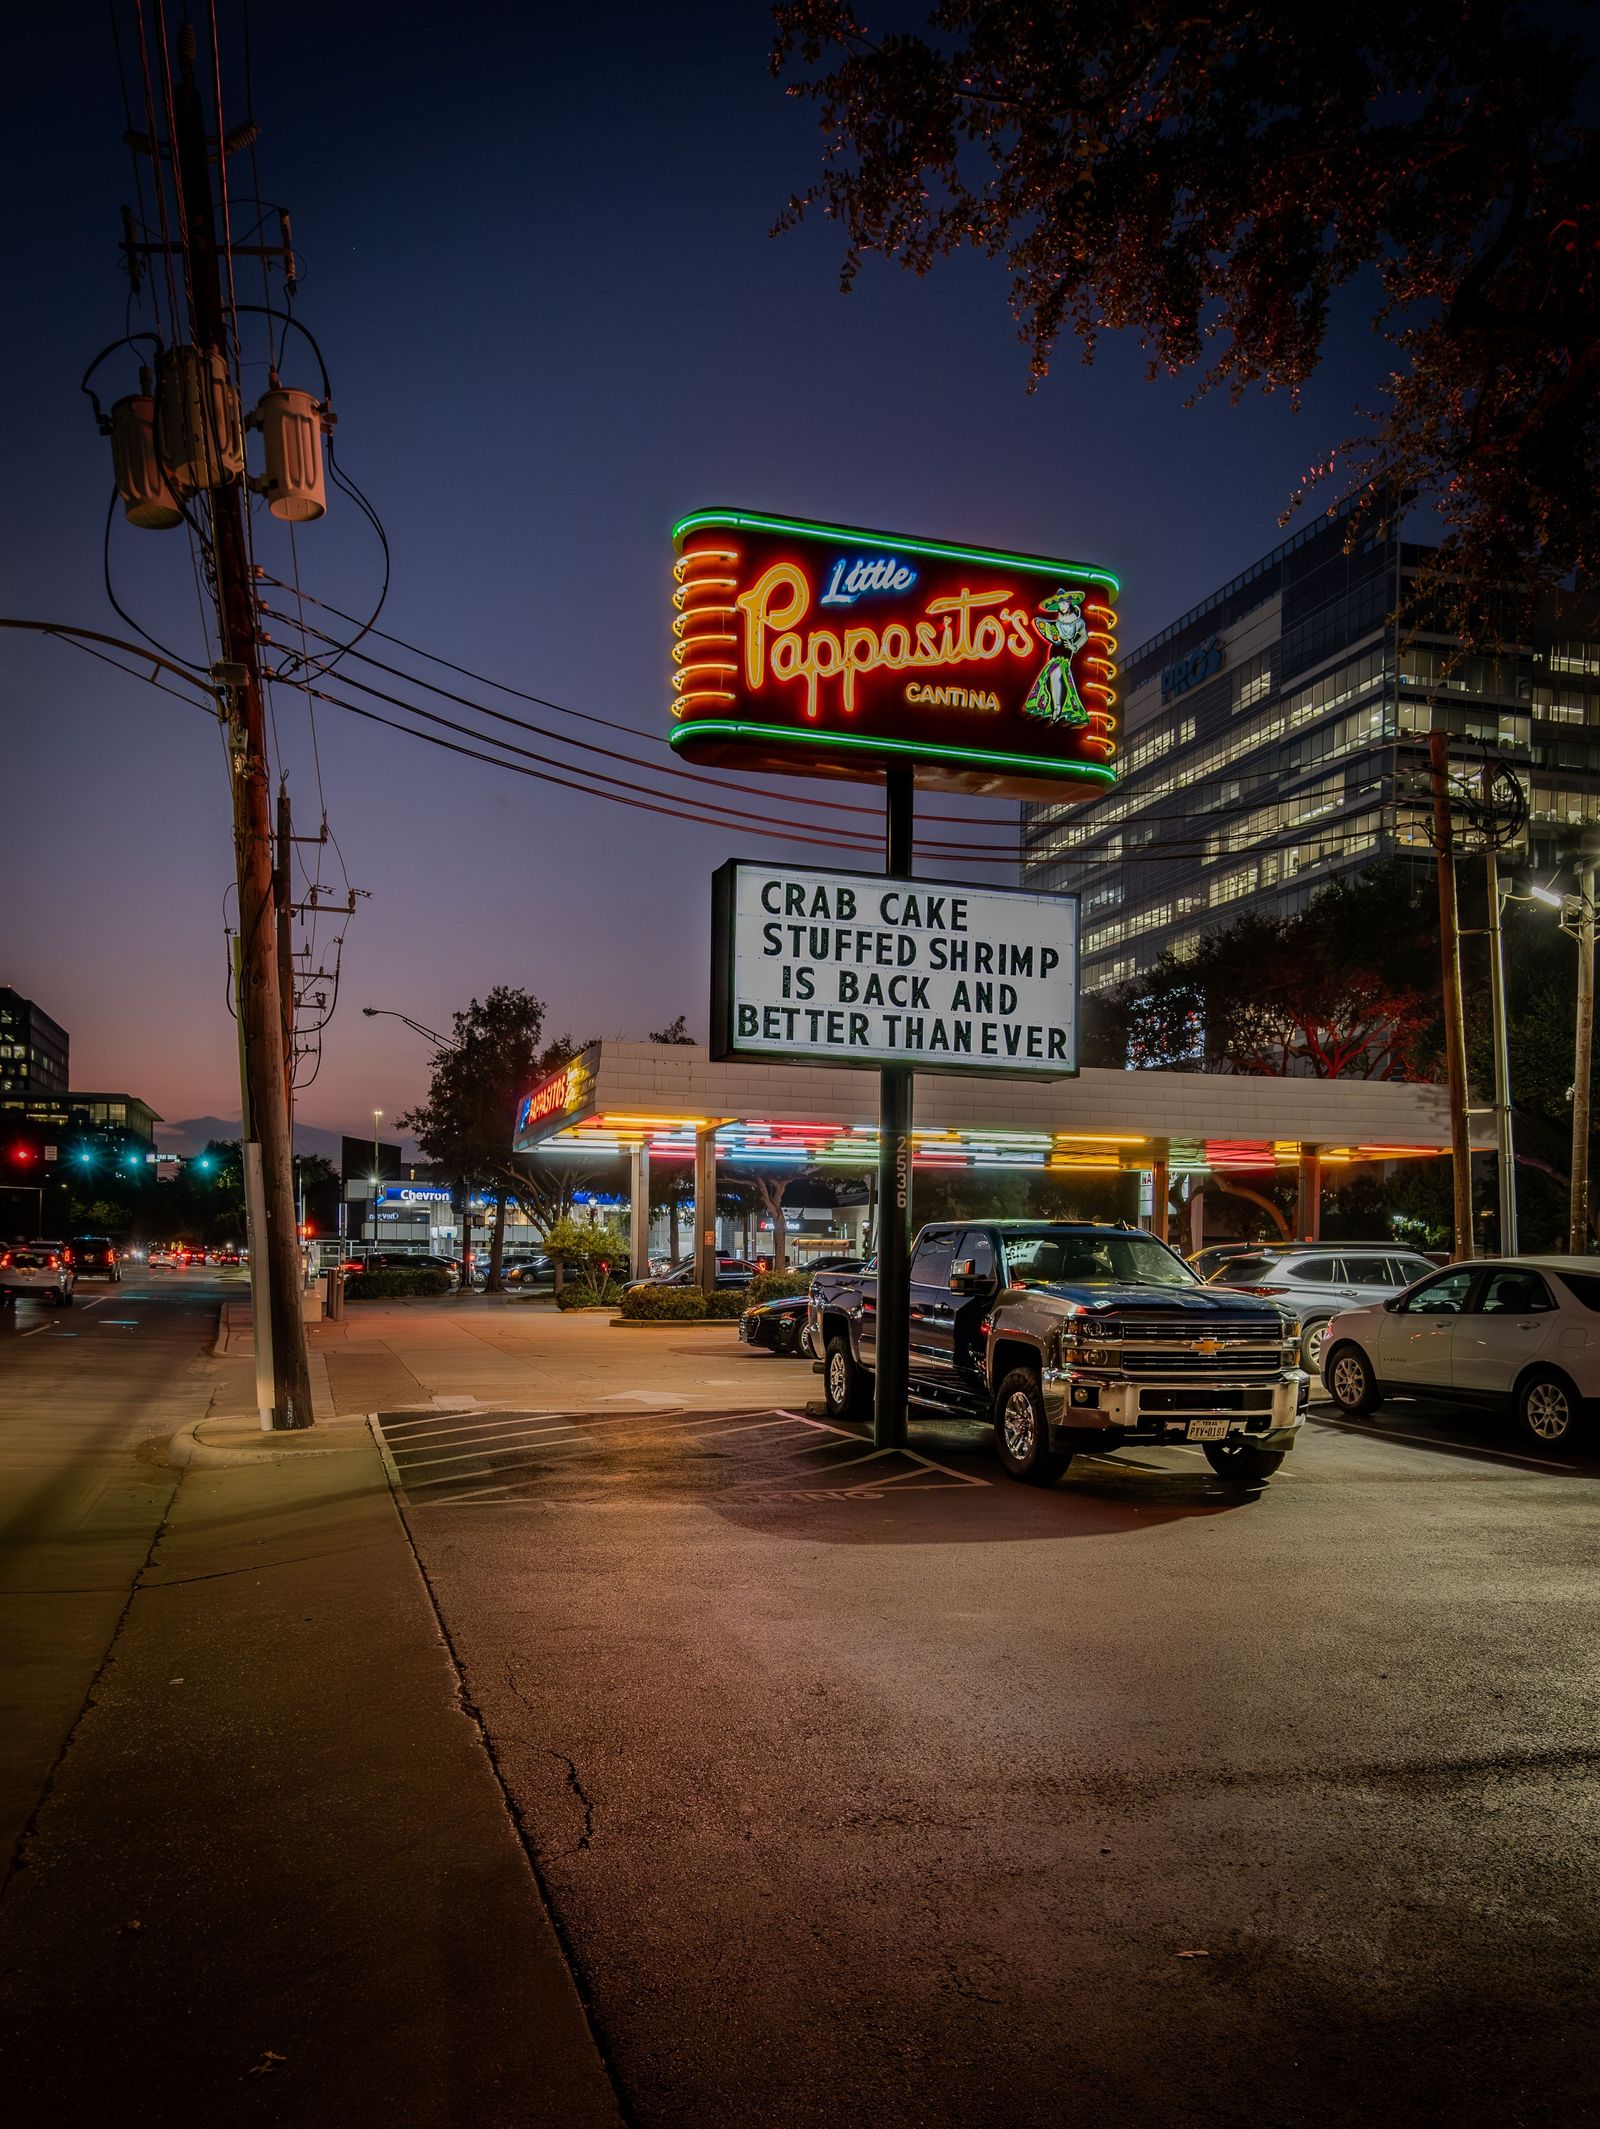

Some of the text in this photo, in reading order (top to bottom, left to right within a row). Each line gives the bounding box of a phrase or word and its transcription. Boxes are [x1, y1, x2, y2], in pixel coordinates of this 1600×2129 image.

[822, 558, 913, 606] Little
[737, 562, 1034, 717] Pappasito's
[905, 682, 1000, 712] CANTINA
[1160, 645, 1222, 704] PROS
[761, 880, 968, 931] CRAB CAKE
[763, 922, 1060, 979] STUFFED SHRIMP
[782, 965, 1018, 1016] IS BACK AND
[738, 1004, 1067, 1060] BETTER THAN EVER
[400, 1189, 449, 1201] Chevron
[896, 1136, 907, 1209] 2536
